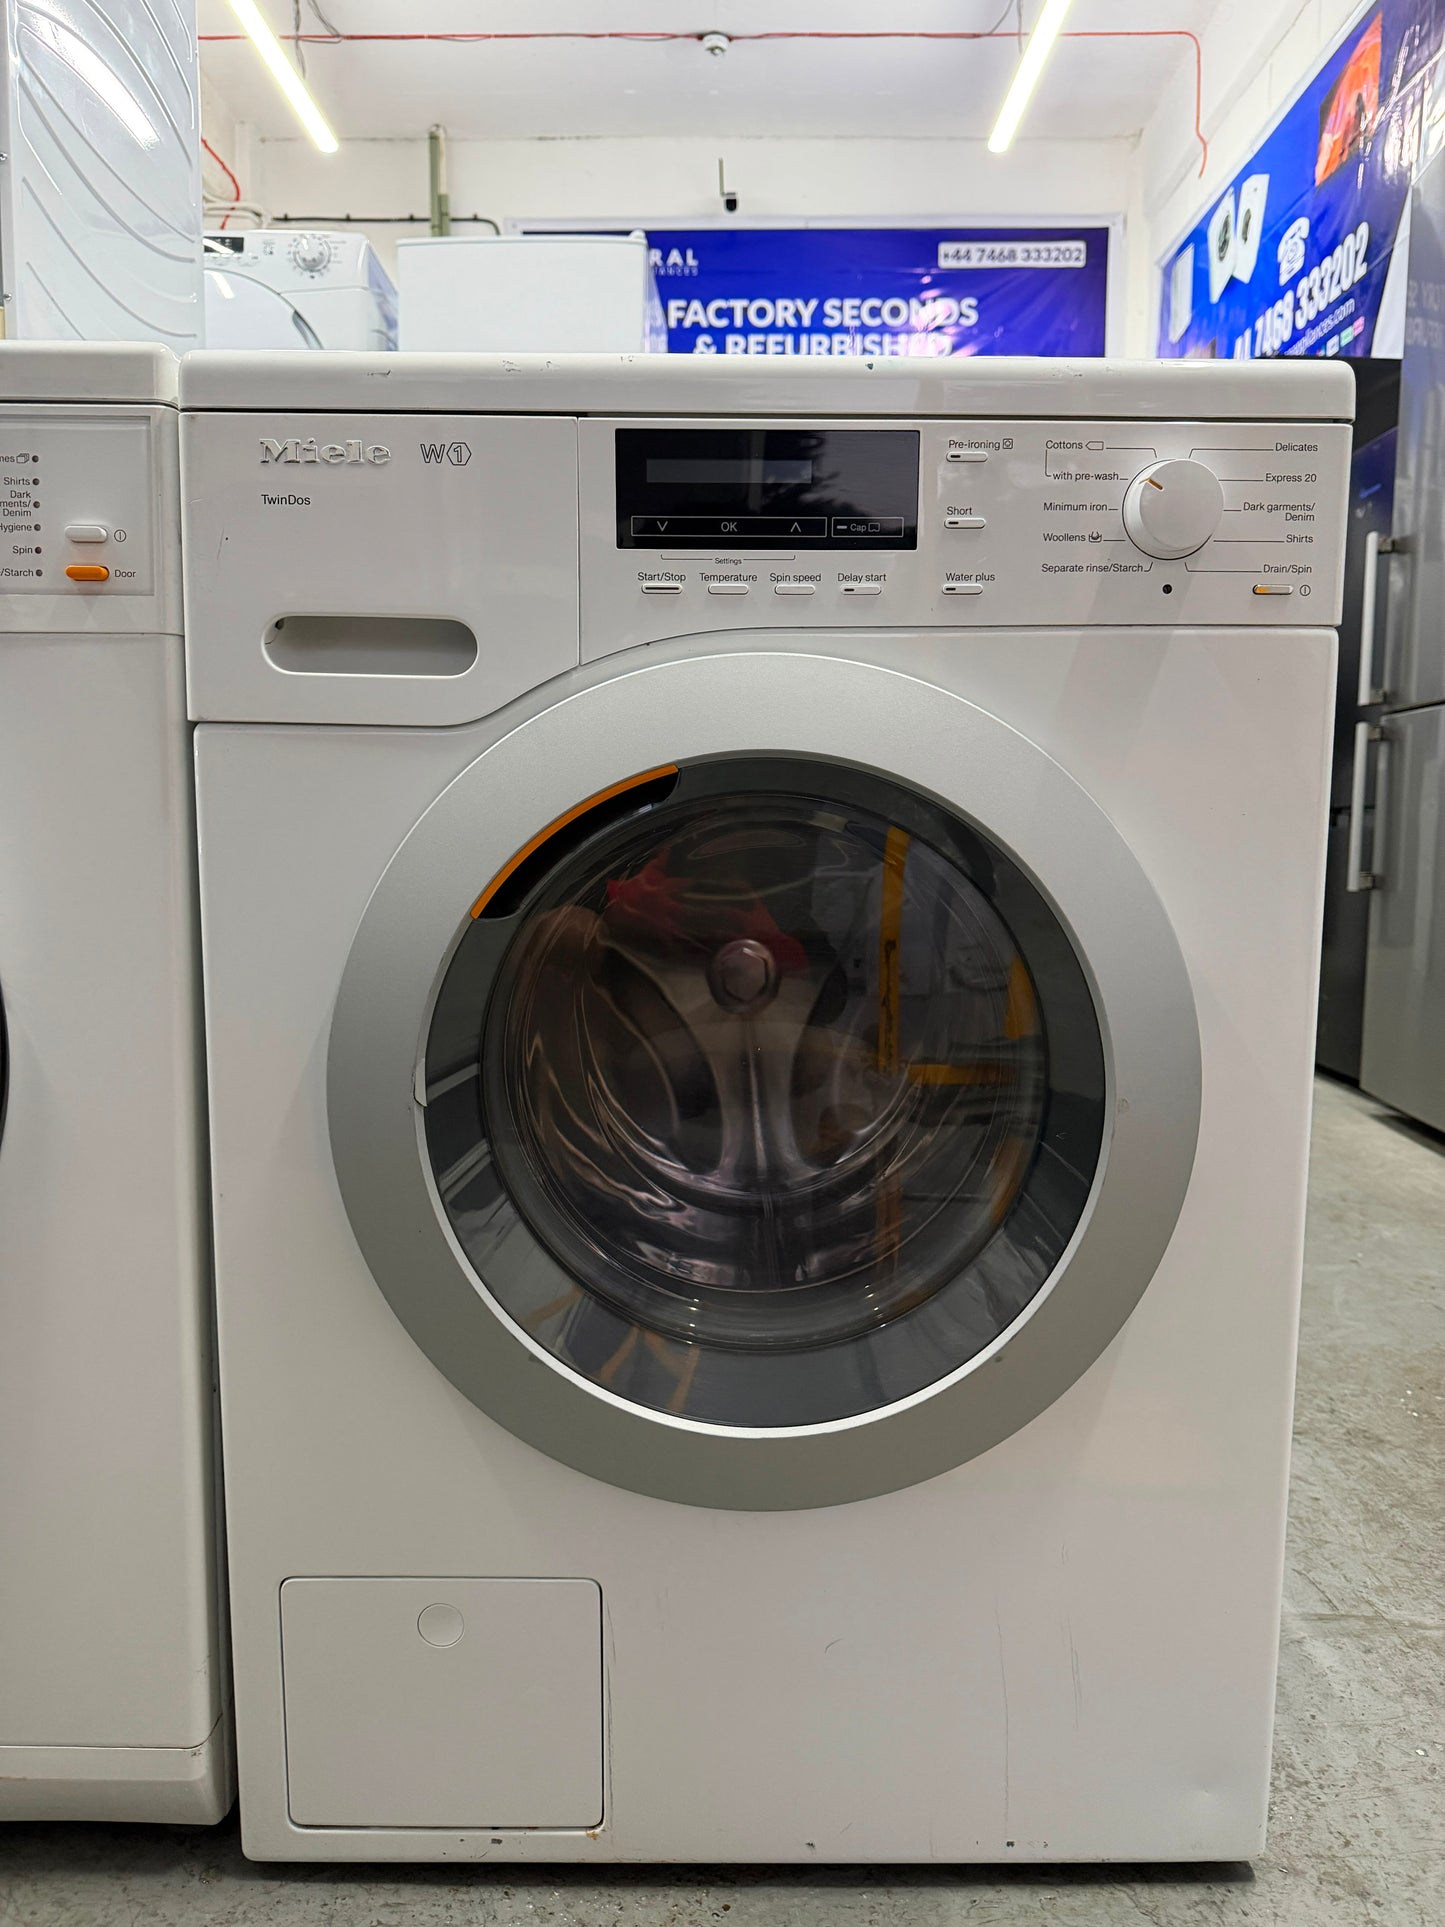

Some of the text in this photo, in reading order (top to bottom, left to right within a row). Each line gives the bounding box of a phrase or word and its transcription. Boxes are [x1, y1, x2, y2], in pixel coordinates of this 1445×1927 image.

[976, 247, 1018, 263] 7468
[1021, 247, 1085, 263] 333202
[1295, 221, 1369, 330] 333202
[667, 297, 979, 328] FACTORY SECONDS
[948, 440, 1001, 451] Pre-ironing
[1045, 440, 1083, 450] Cottons
[1275, 442, 1318, 452] Delicates
[259, 437, 392, 465] Miele
[3, 477, 31, 486] Shirts
[1053, 472, 1119, 482] with pre-wash
[1265, 473, 1317, 484] Express 20
[10, 490, 31, 499] Dark
[261, 494, 311, 506] TwinDos
[946, 506, 973, 516] Short
[1043, 502, 1108, 512] Minimum iron
[1243, 502, 1316, 513] Dark garments/
[3, 509, 31, 517] Denim
[1285, 512, 1315, 521] Denim
[721, 521, 738, 532] OK
[850, 523, 867, 533] Cap
[1042, 532, 1086, 542] Woollens
[1286, 534, 1314, 543] Shirts
[13, 546, 33, 555] Spin
[714, 557, 742, 566] Settings
[114, 569, 136, 578] Door
[1041, 563, 1144, 575] Separate rinse/Starch
[1263, 564, 1313, 575] Drain/Spin
[637, 571, 687, 583] Start/Stop
[699, 572, 758, 583] Temperature
[769, 572, 822, 583] Spin speed
[837, 572, 887, 584] Delay start
[946, 572, 996, 583] Water plus
